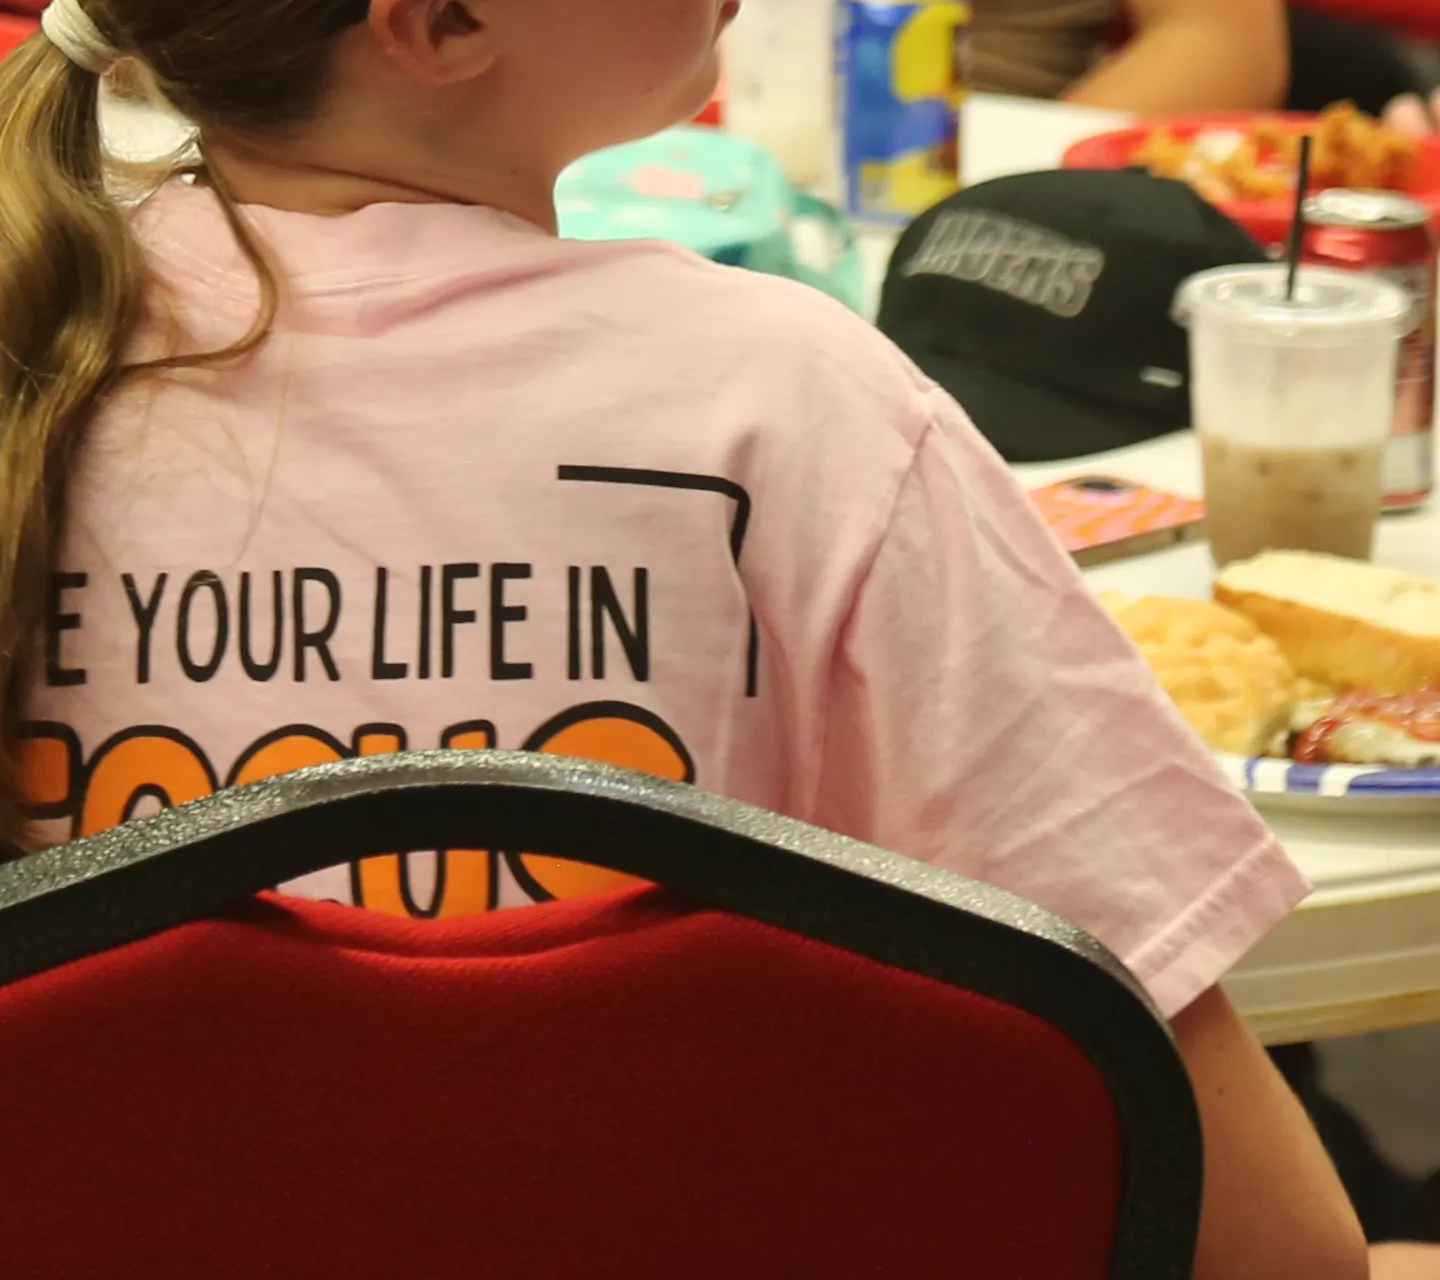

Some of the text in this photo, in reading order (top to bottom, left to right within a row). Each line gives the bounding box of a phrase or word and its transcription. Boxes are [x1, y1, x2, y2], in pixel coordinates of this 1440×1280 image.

[121, 566, 342, 685] YOUR
[370, 562, 534, 681] LIFE
[566, 564, 651, 682] IN
